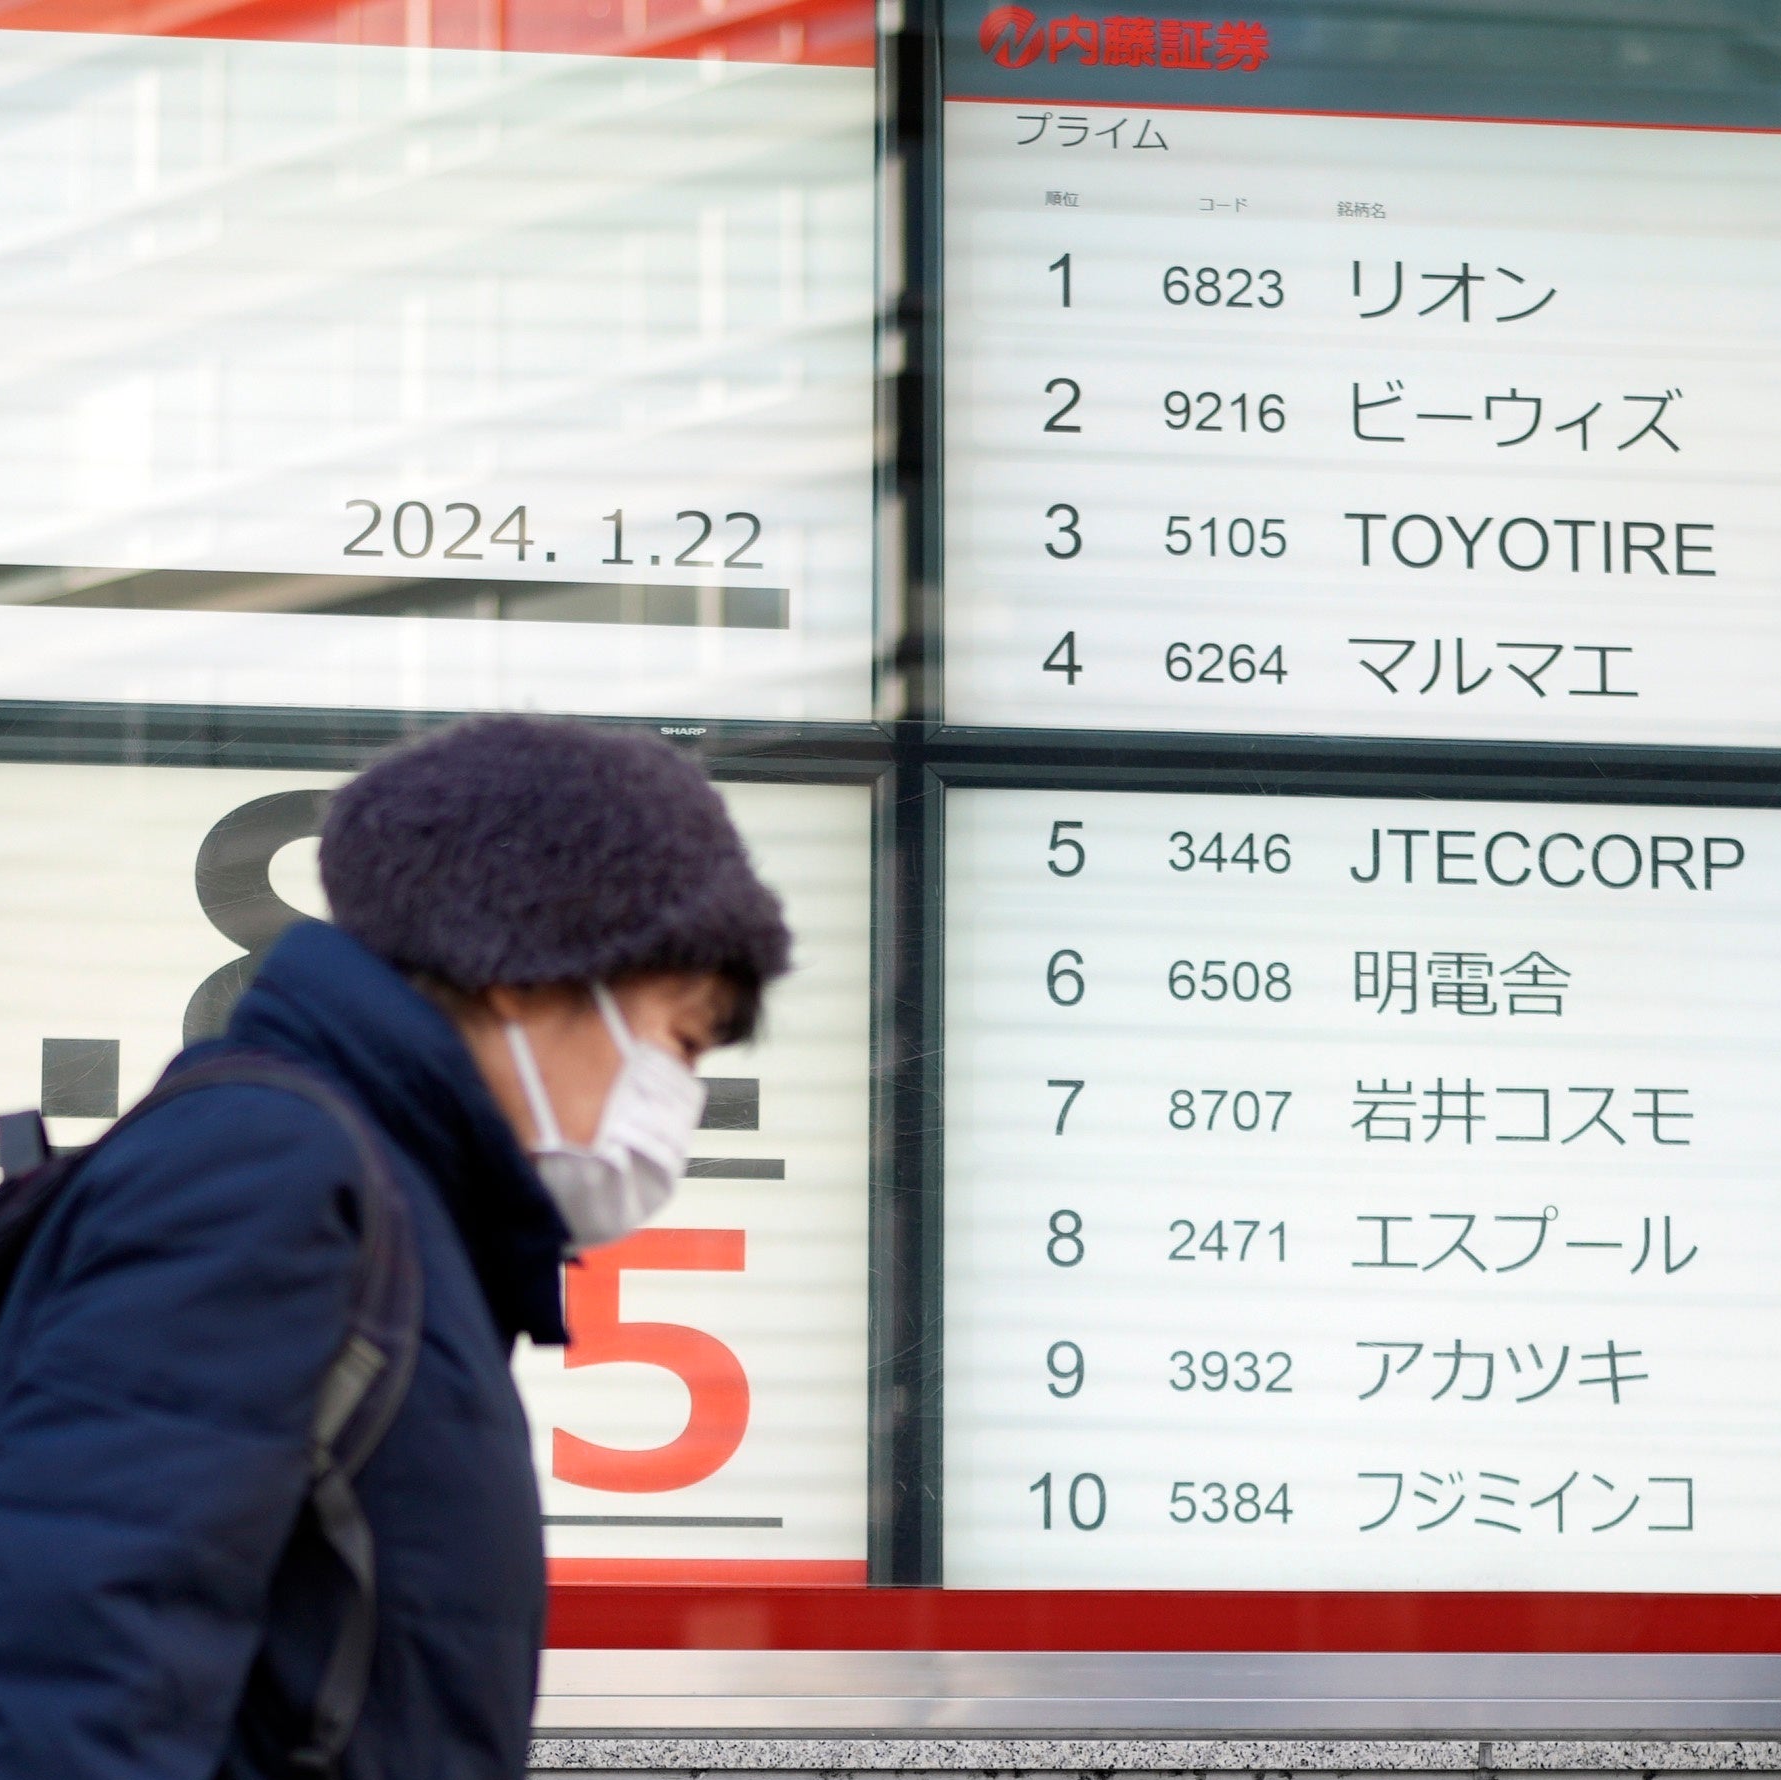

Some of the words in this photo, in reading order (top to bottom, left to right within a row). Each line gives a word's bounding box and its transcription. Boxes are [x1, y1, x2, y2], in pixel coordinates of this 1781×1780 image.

[1047, 15, 1271, 72] 内藤証券
[1016, 112, 1169, 152] プライム
[1199, 197, 1248, 213] コード
[1048, 253, 1071, 307] 1
[1162, 266, 1285, 309] 6823
[1353, 260, 1558, 323] リオン
[1043, 378, 1082, 433] 2
[1163, 390, 1286, 433] 9216
[1352, 380, 1684, 452] ビーウィズ
[343, 499, 557, 564] 2024.
[602, 509, 765, 569] 1.22
[1044, 503, 1083, 560] 3
[1164, 516, 1288, 559] 5105
[1345, 513, 1717, 576] TOYOTIRE
[1042, 631, 1083, 686] 4
[1165, 642, 1289, 685] 6264
[1348, 637, 1640, 698] マルマエ
[661, 727, 707, 736] SHARP
[1047, 821, 1086, 877] 5
[1168, 831, 1293, 875] 3446
[1350, 828, 1745, 891] JTECCORP
[1046, 949, 1086, 1007] 6
[1168, 960, 1293, 1003] 6508
[1355, 951, 1573, 1017] 明電舎
[1047, 1079, 1086, 1136] 7
[1169, 1089, 1293, 1132] 8707
[1351, 1077, 1695, 1146] 岩井コスモ
[1046, 1209, 1085, 1268] 8
[1168, 1219, 1288, 1262] 2471
[1351, 1205, 1699, 1275] エスプール
[1046, 1341, 1085, 1399] 9
[1169, 1350, 1294, 1393] 3932
[1355, 1339, 1650, 1405] アカツキ
[1029, 1472, 1108, 1531] 10
[1169, 1482, 1294, 1525] 5384
[1357, 1471, 1694, 1534] フジミインコ
